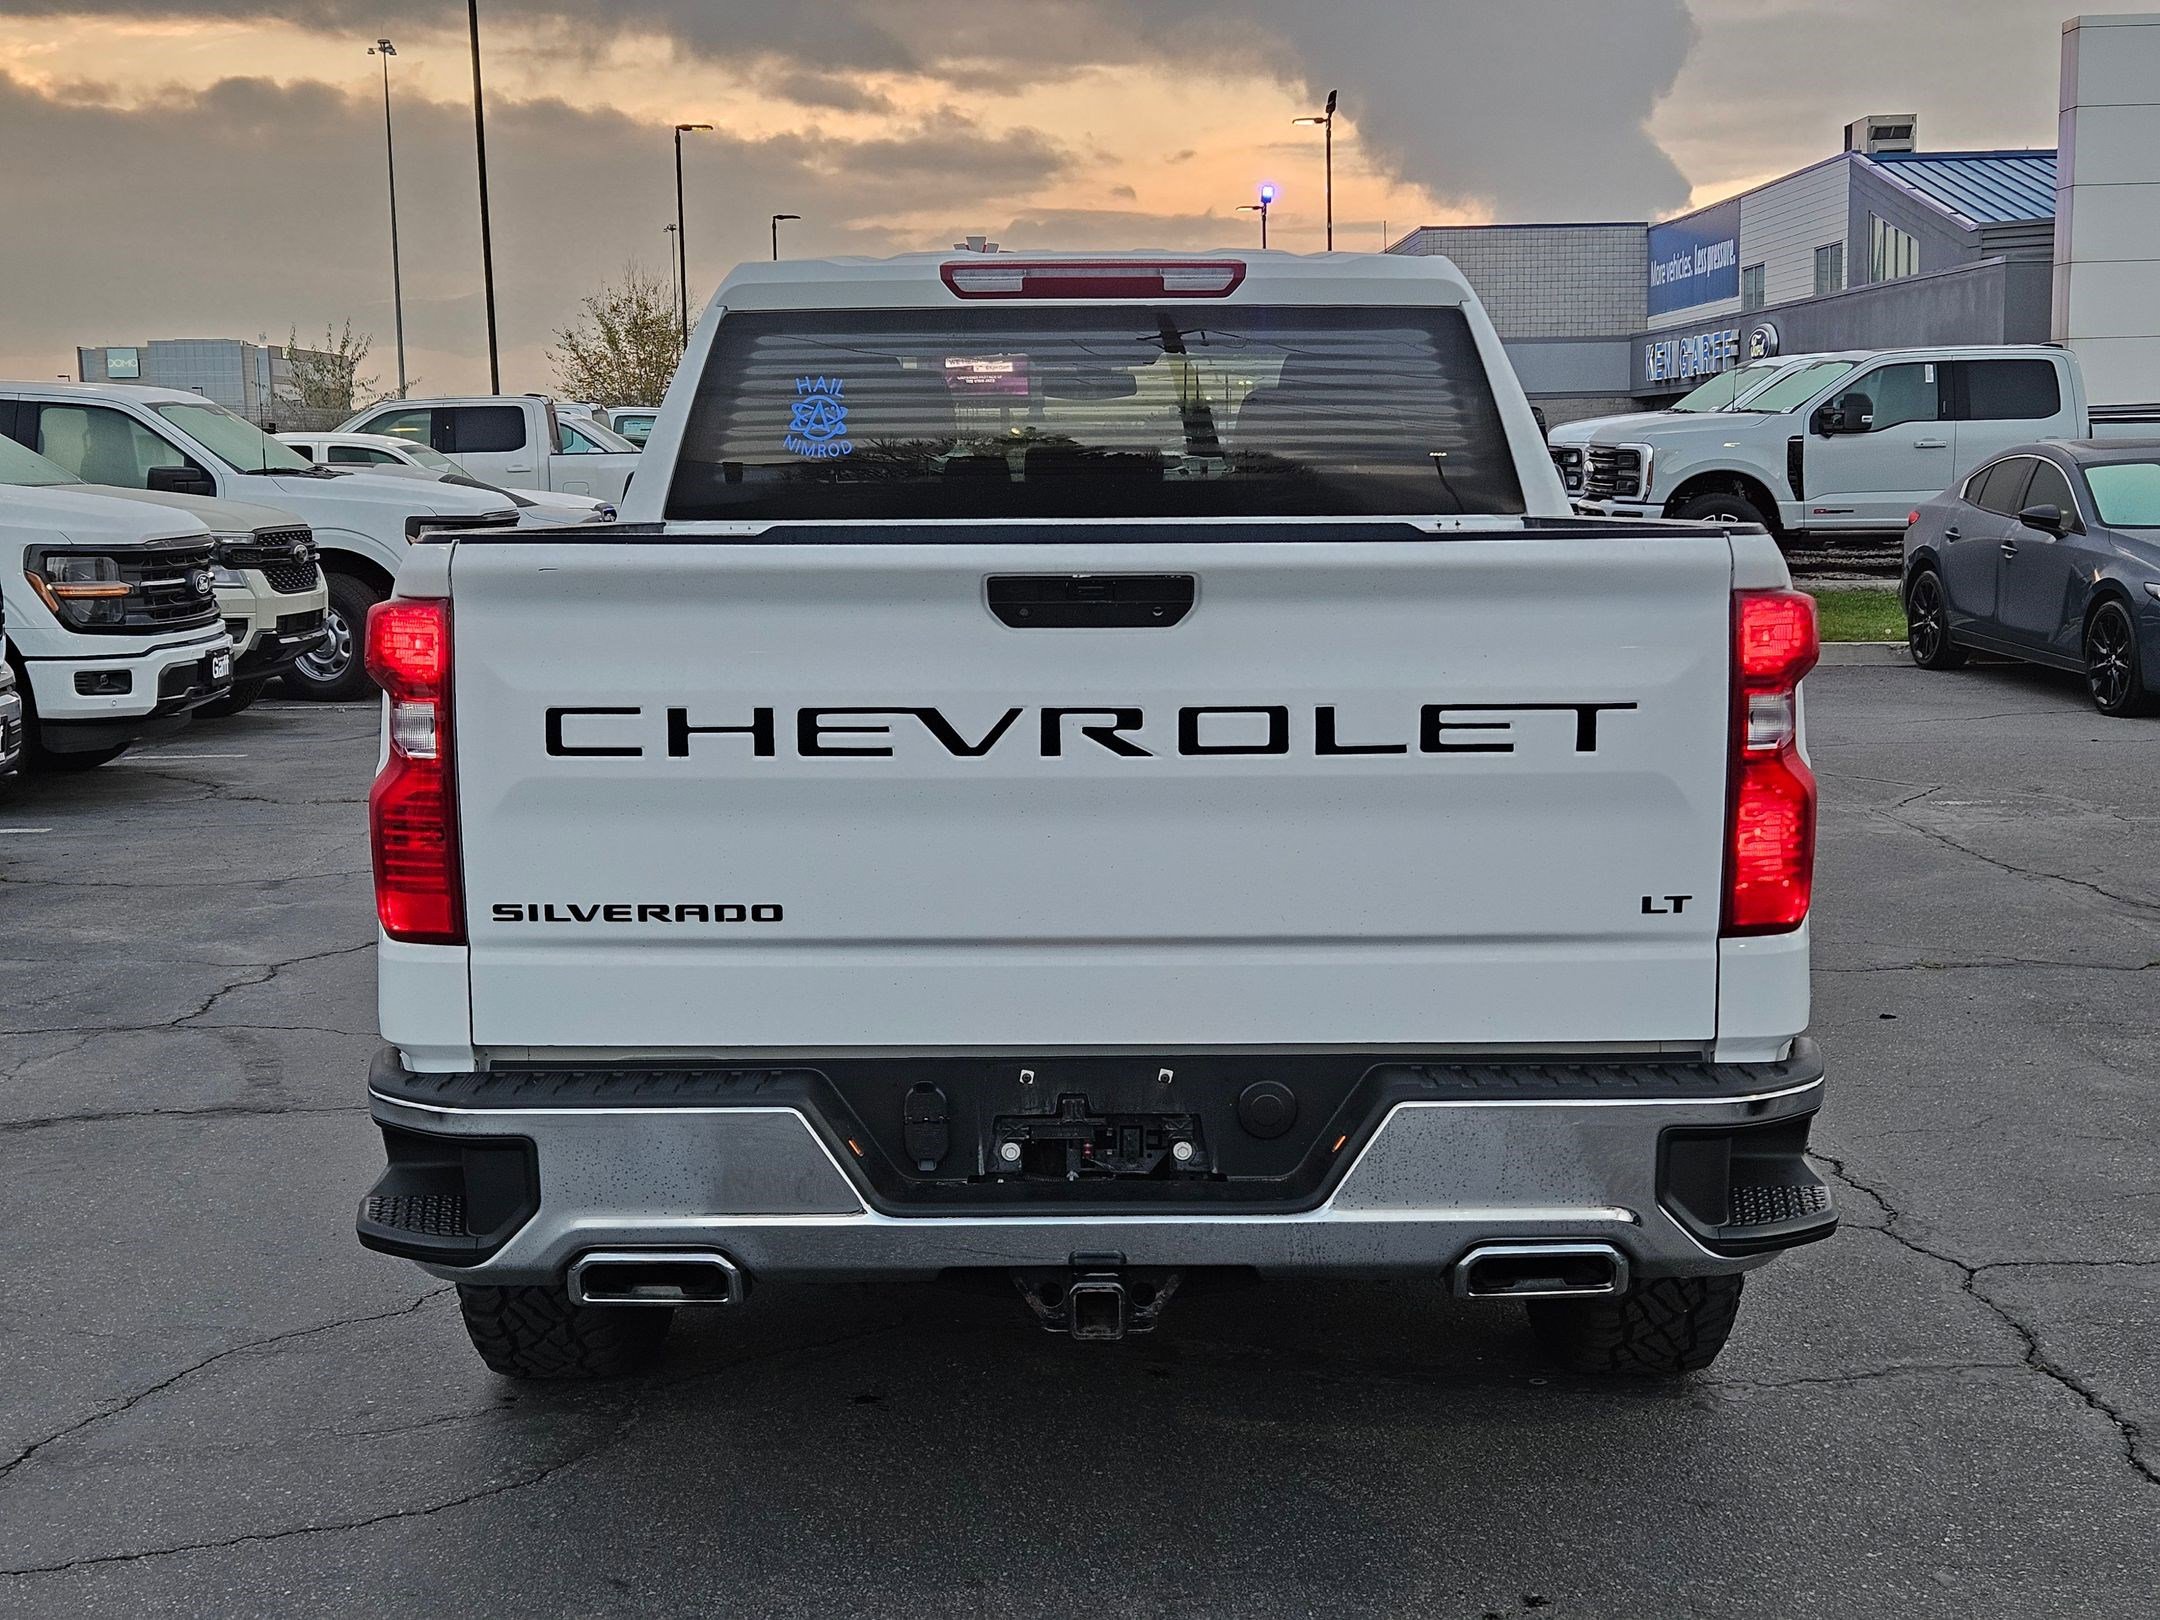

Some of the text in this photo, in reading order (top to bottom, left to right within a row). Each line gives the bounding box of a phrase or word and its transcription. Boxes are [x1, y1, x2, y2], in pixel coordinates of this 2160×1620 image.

[1650, 238, 1736, 288] More vehicles. Less pressure.
[107, 358, 137, 367] DOMO
[1645, 328, 1740, 382] KEN GARFF
[796, 376, 844, 398] HAIL
[783, 434, 852, 457] NIMROD
[546, 702, 1637, 757] CHEVROLET
[492, 903, 784, 923] SILVERADO
[1641, 895, 1692, 914] LT
